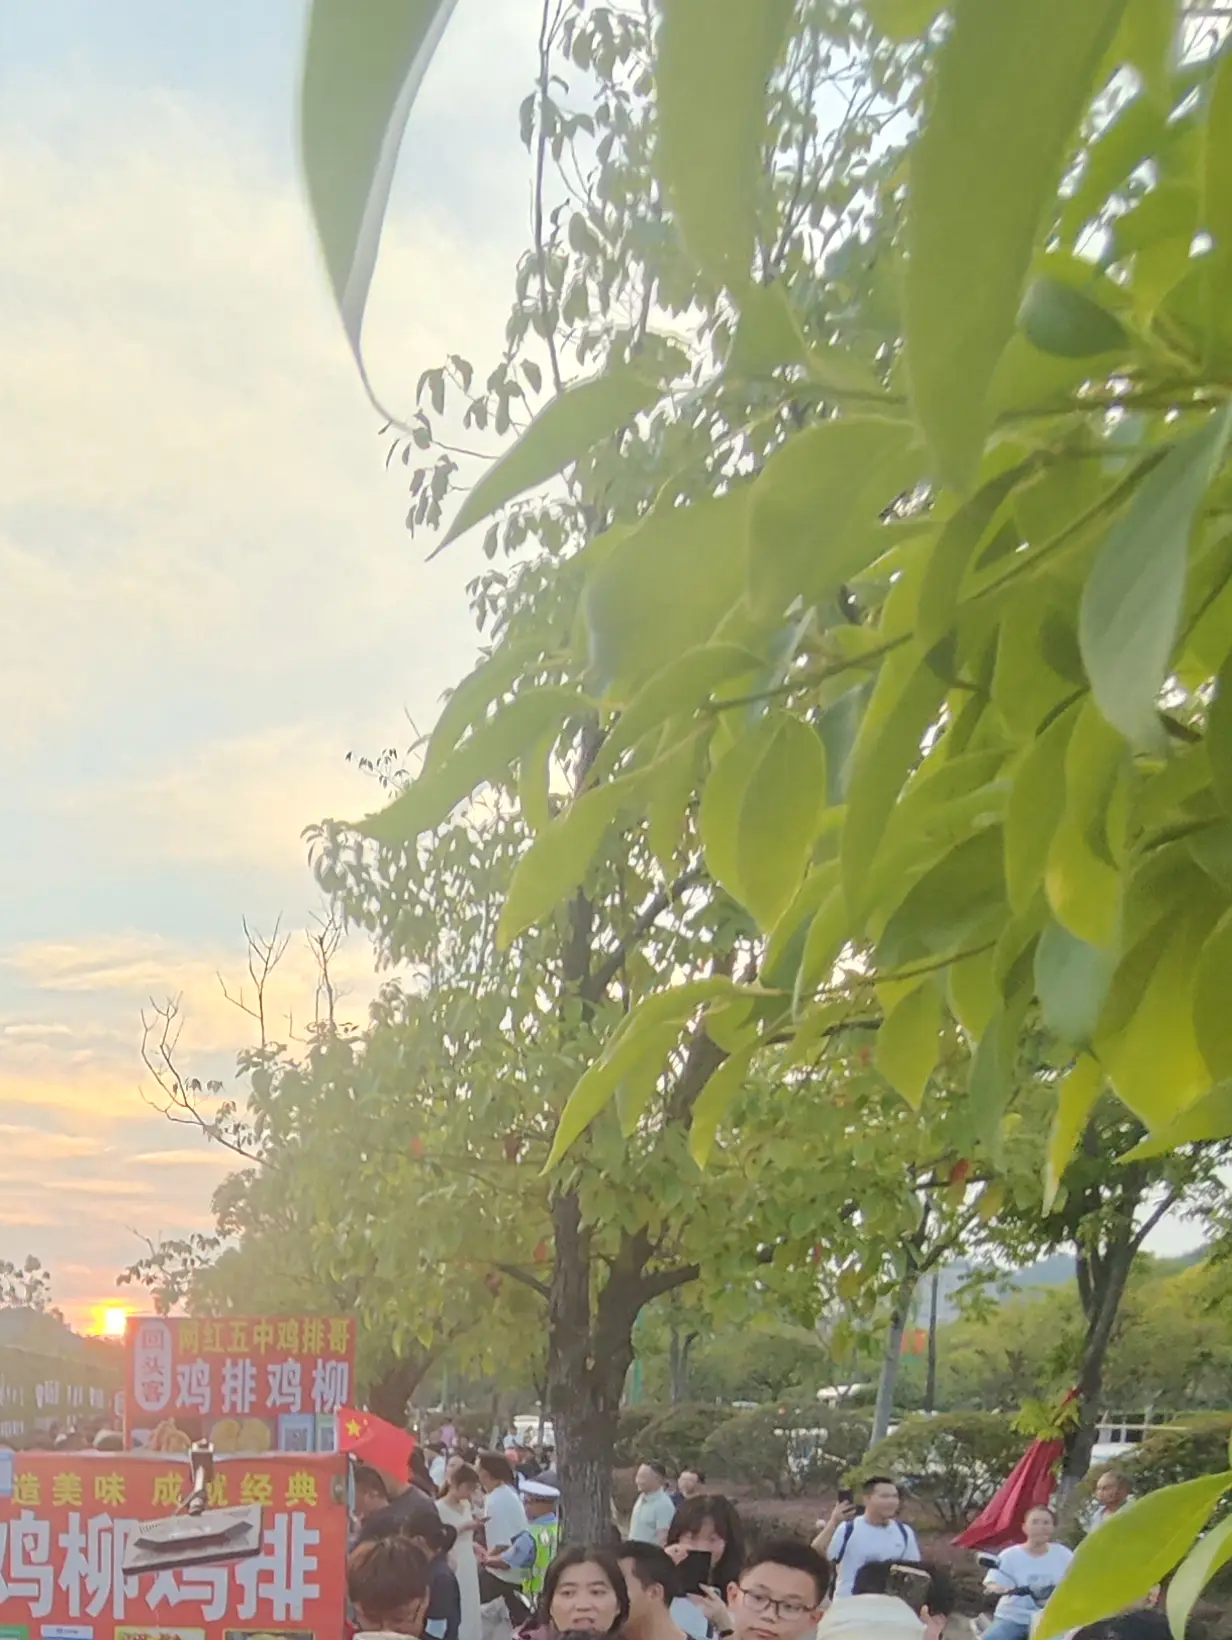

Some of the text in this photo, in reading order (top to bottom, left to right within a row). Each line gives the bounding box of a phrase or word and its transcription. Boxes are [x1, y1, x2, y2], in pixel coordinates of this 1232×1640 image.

[179, 1318, 350, 1354] 网红五中鸡排哥
[141, 1330, 165, 1403] 回头客
[176, 1358, 349, 1414] 鸡排鸡柳
